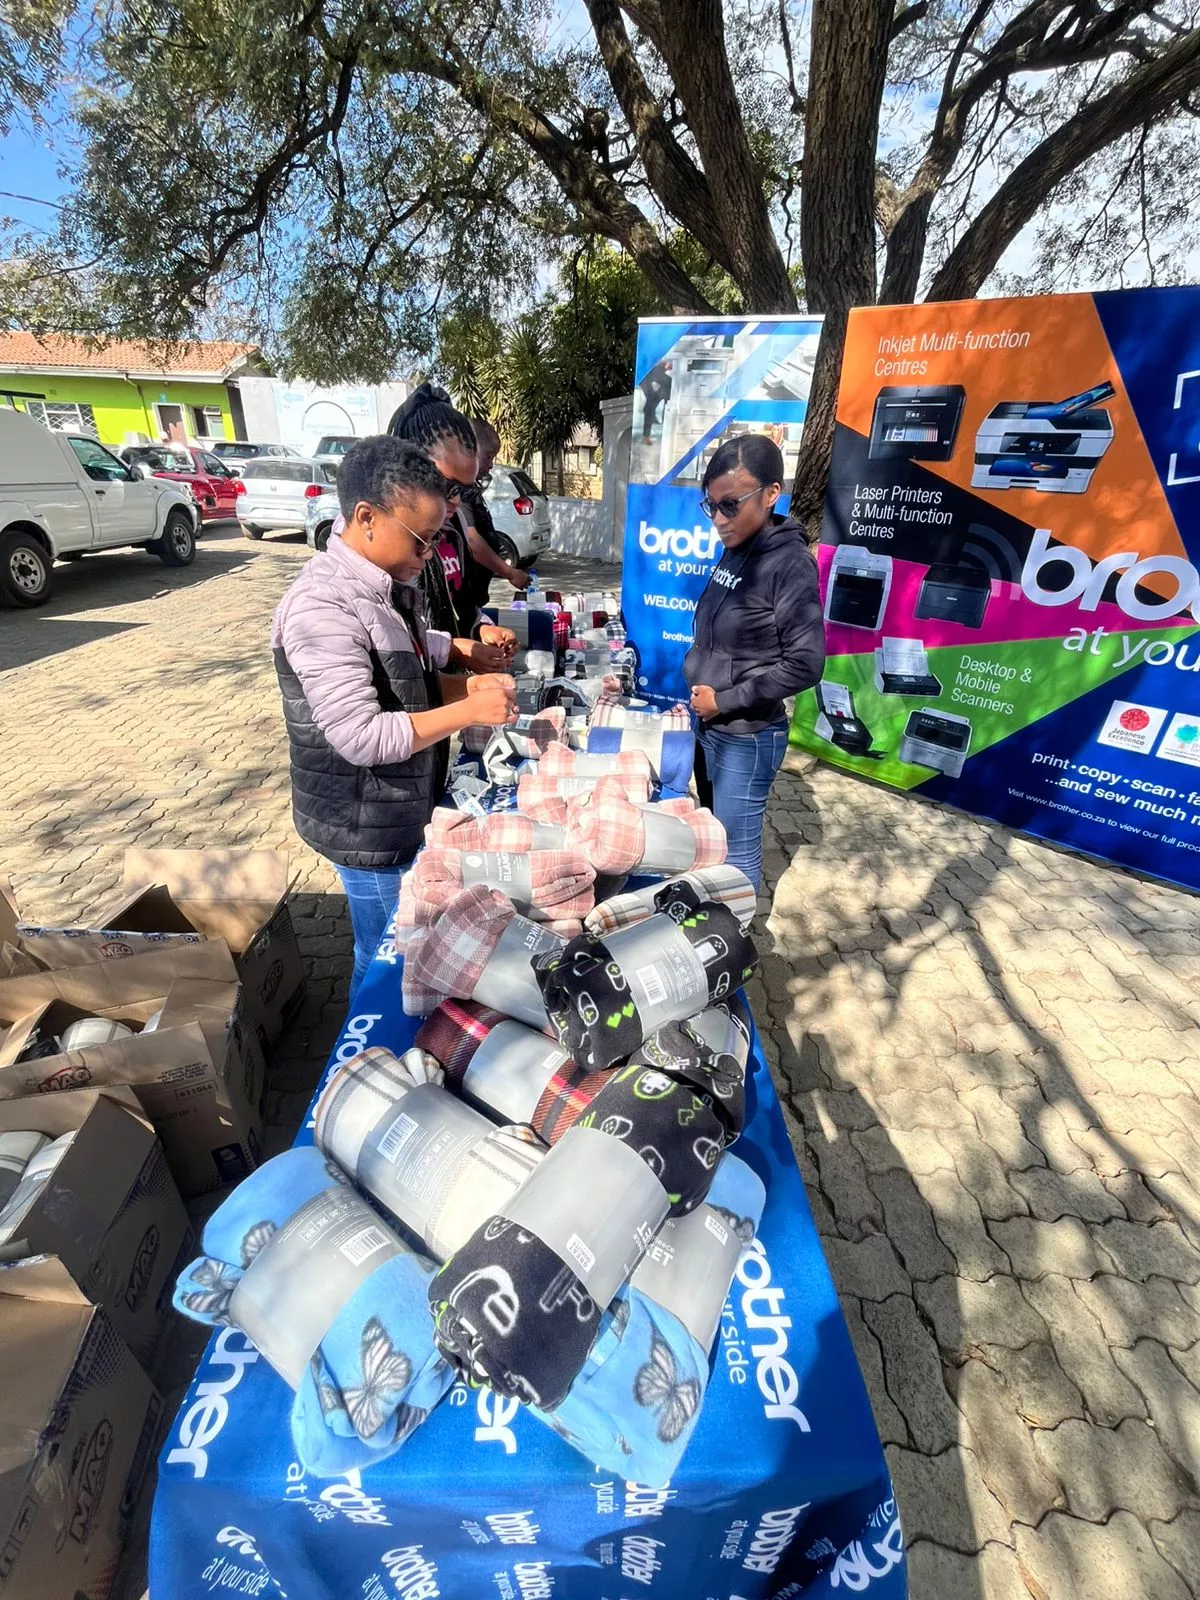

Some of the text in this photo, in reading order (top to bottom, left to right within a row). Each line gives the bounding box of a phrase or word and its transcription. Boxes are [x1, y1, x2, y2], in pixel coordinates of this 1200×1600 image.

[877, 331, 1031, 357] Inkjet Multi-function
[874, 358, 928, 377] Centres
[854, 484, 943, 504] Laser Printers
[852, 503, 953, 525] & Multi-function
[639, 521, 726, 559] broth
[849, 521, 895, 539] Centres
[658, 559, 673, 572] at
[675, 562, 708, 577] your
[1021, 528, 1200, 625] bro
[643, 593, 699, 612] WELCOM
[1063, 626, 1200, 672] at you
[960, 655, 1032, 683] Desktop &
[955, 672, 1000, 694] Mobile
[951, 688, 1015, 714] Scanners
[1107, 732, 1145, 745] Excellence
[1112, 728, 1146, 739] Japanese
[1032, 752, 1200, 806] print copy scan fa
[1008, 787, 1025, 799] Visit
[1026, 793, 1105, 824] www.brother.co.za
[1108, 818, 1118, 827] to
[1119, 823, 1141, 835] view
[1142, 830, 1159, 840] our
[1161, 834, 1177, 845] full
[1094, 787, 1131, 805] sew
[1133, 798, 1187, 821] much
[736, 1238, 811, 1433] other
[721, 1326, 749, 1384] side
[202, 1556, 226, 1581] at
[208, 1560, 246, 1591] your
[239, 1568, 270, 1597] side
